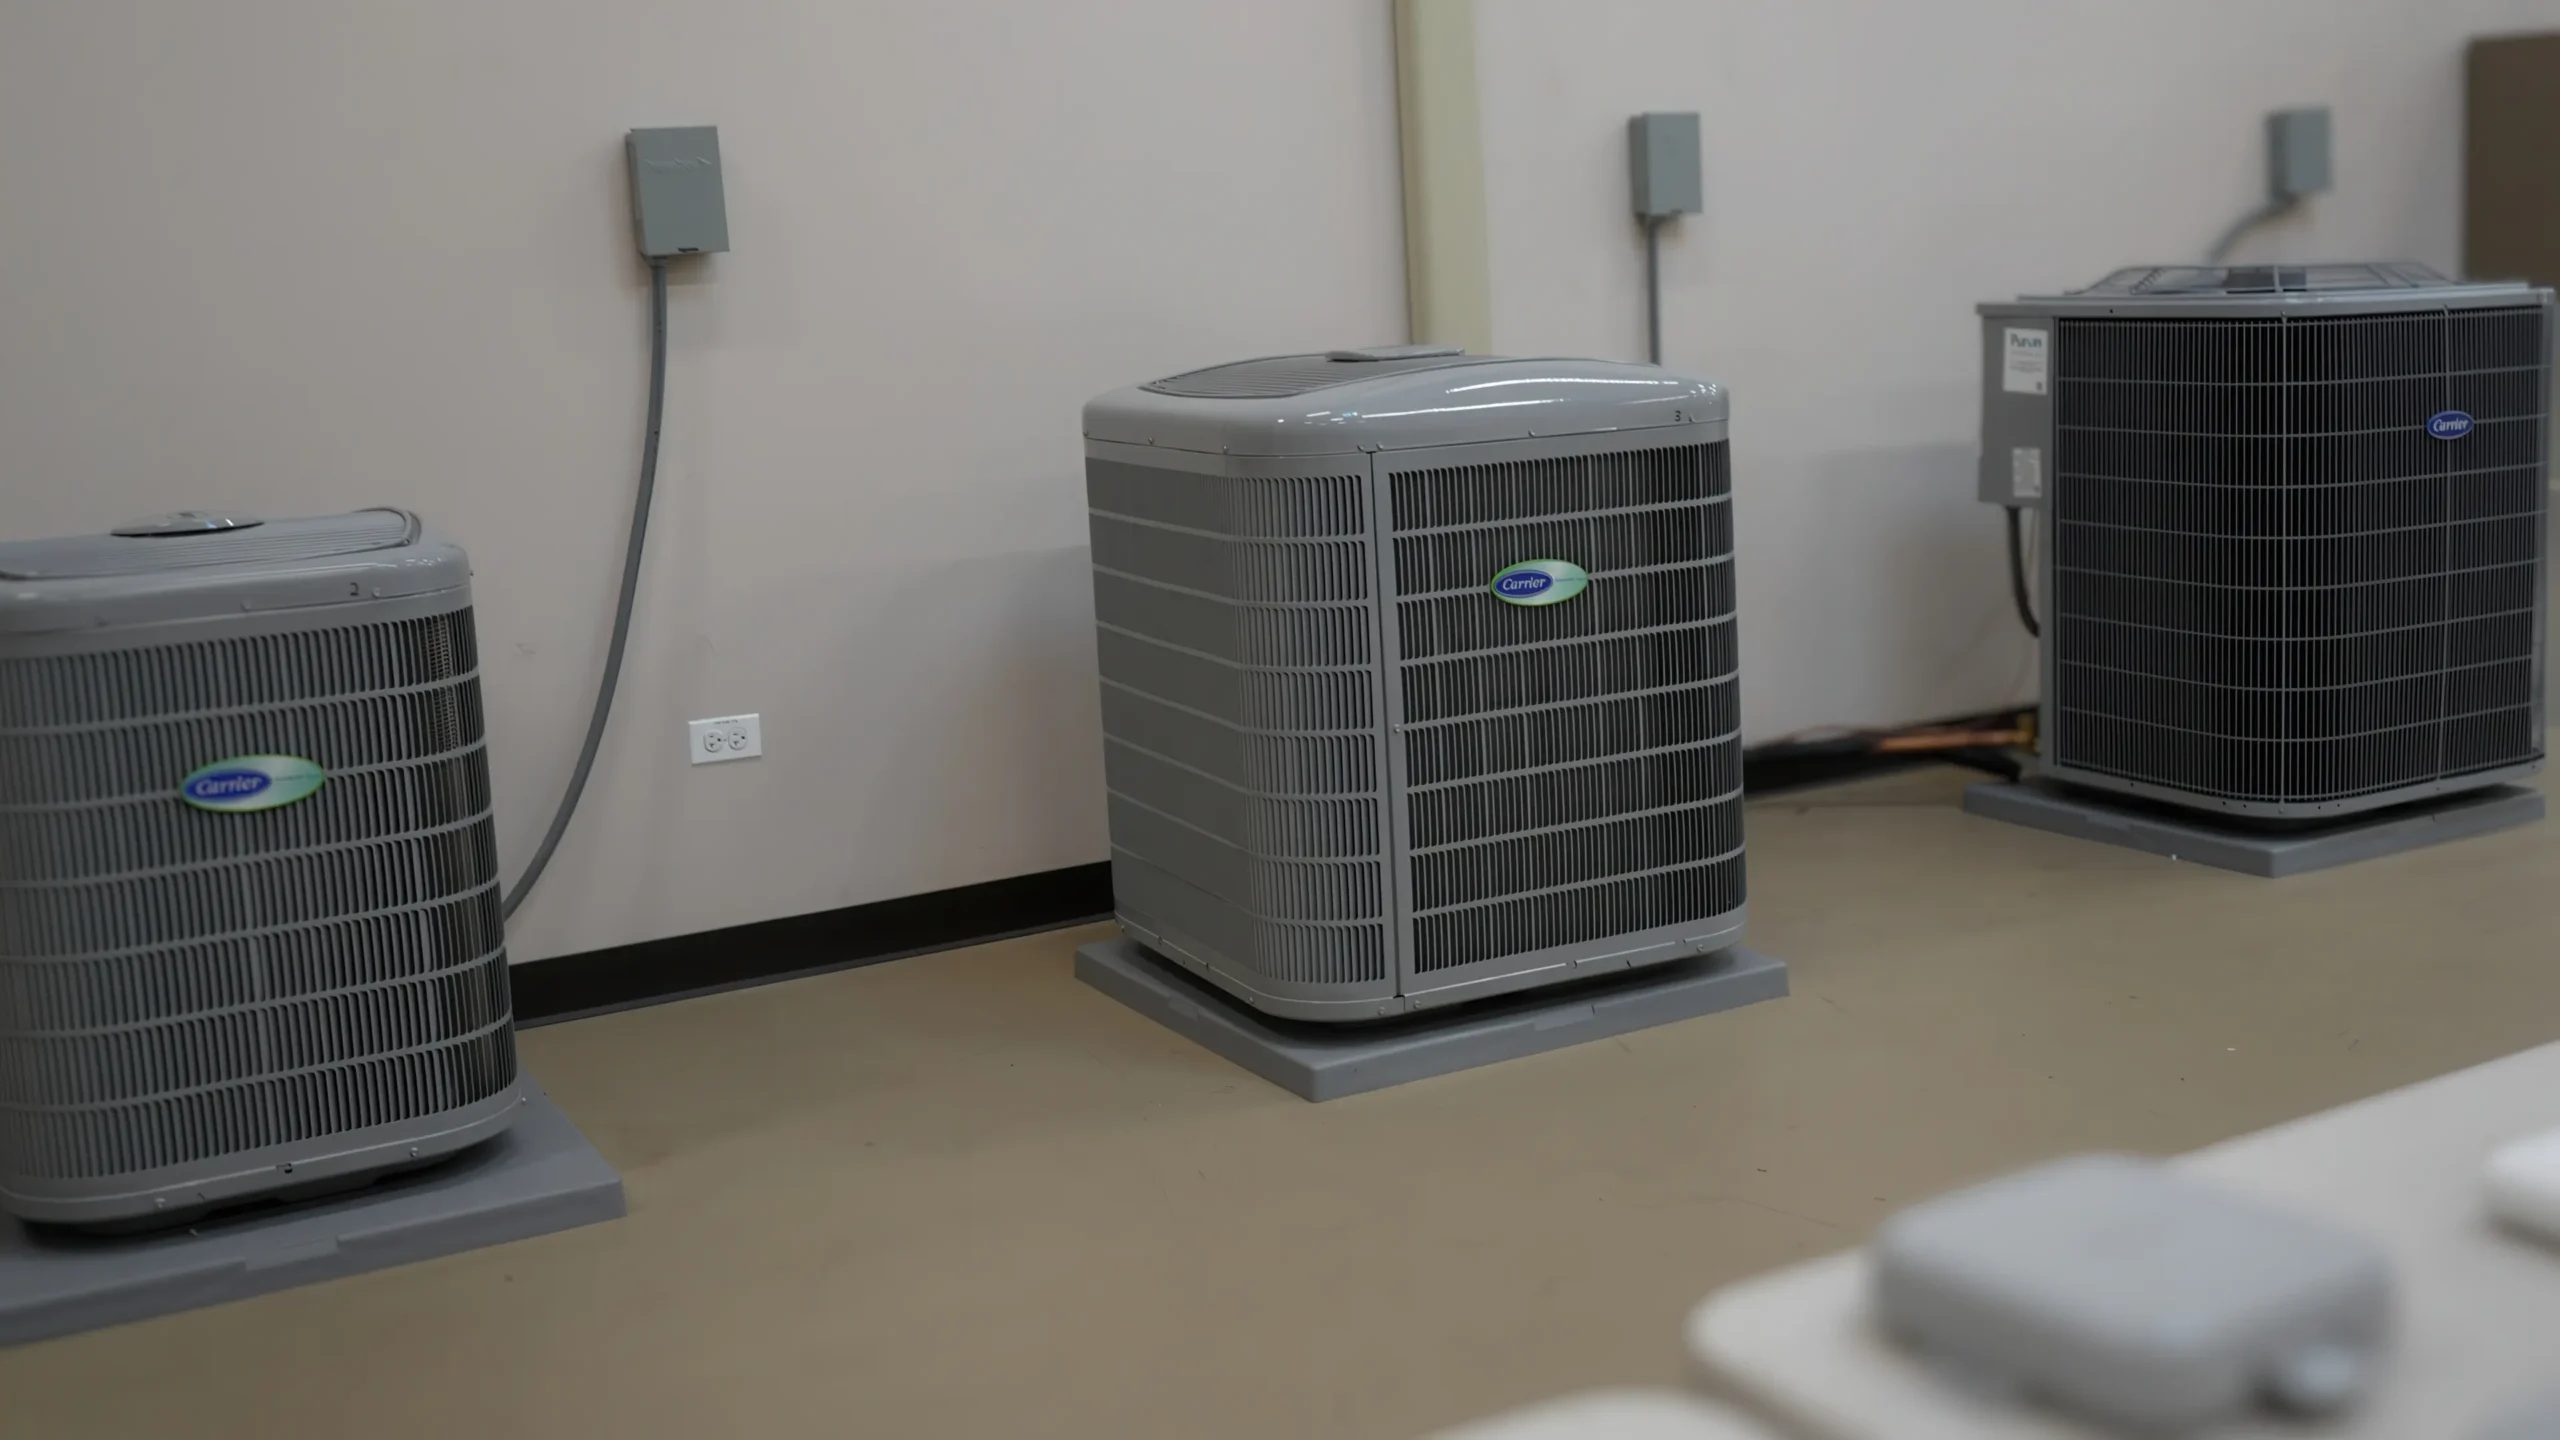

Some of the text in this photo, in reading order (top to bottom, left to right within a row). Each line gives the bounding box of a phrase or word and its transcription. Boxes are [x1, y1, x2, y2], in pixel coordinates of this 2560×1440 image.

[1675, 410, 1681, 422] 3
[2433, 417, 2468, 432] Carrier
[1502, 576, 1546, 590] Carrier
[195, 775, 263, 796] Carrier
